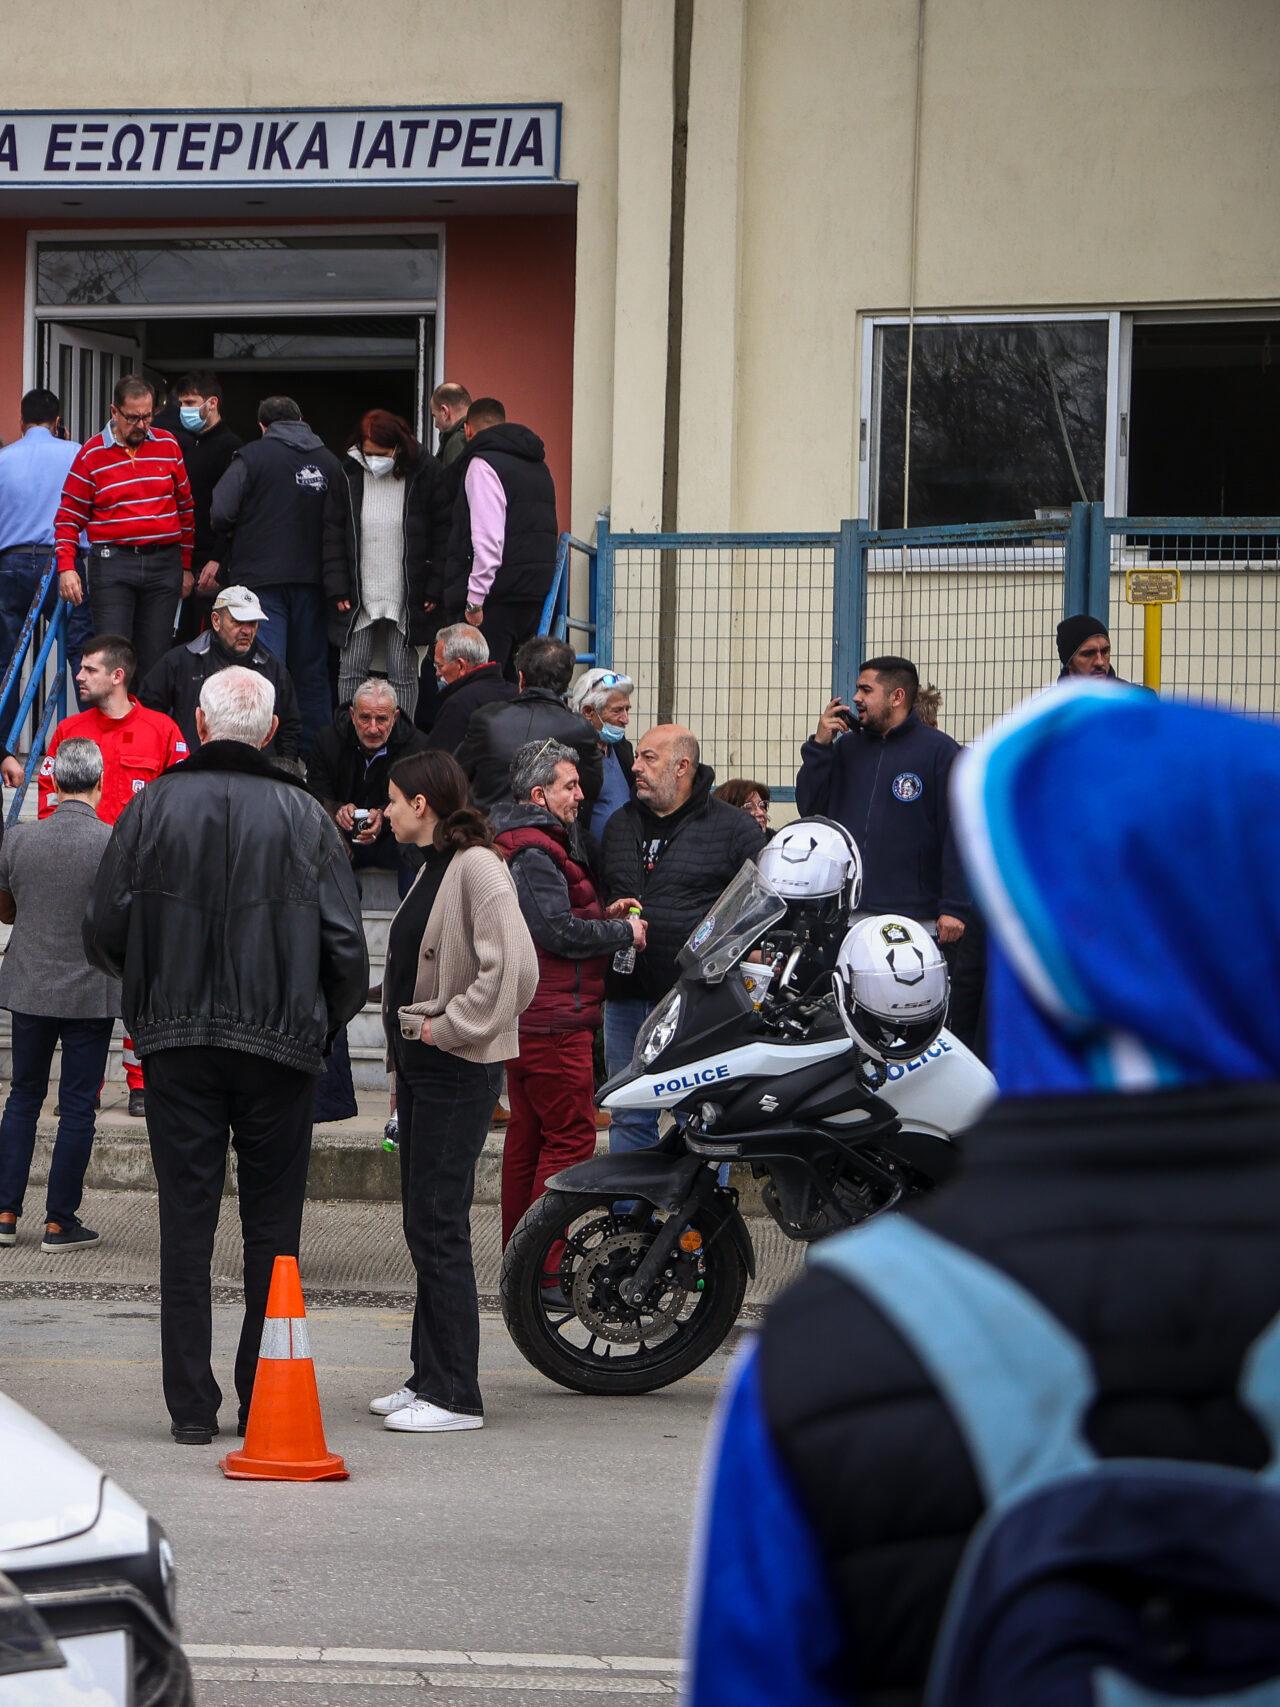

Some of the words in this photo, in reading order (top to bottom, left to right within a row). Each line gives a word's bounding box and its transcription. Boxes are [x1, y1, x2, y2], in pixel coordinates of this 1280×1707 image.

[43, 120, 330, 172] ΕΞΩΤΕΡΙΚΑ
[348, 117, 544, 169] ΙΑΤΡΕΙΑ
[890, 998, 932, 1010] LS2
[653, 1064, 730, 1097] POLICE
